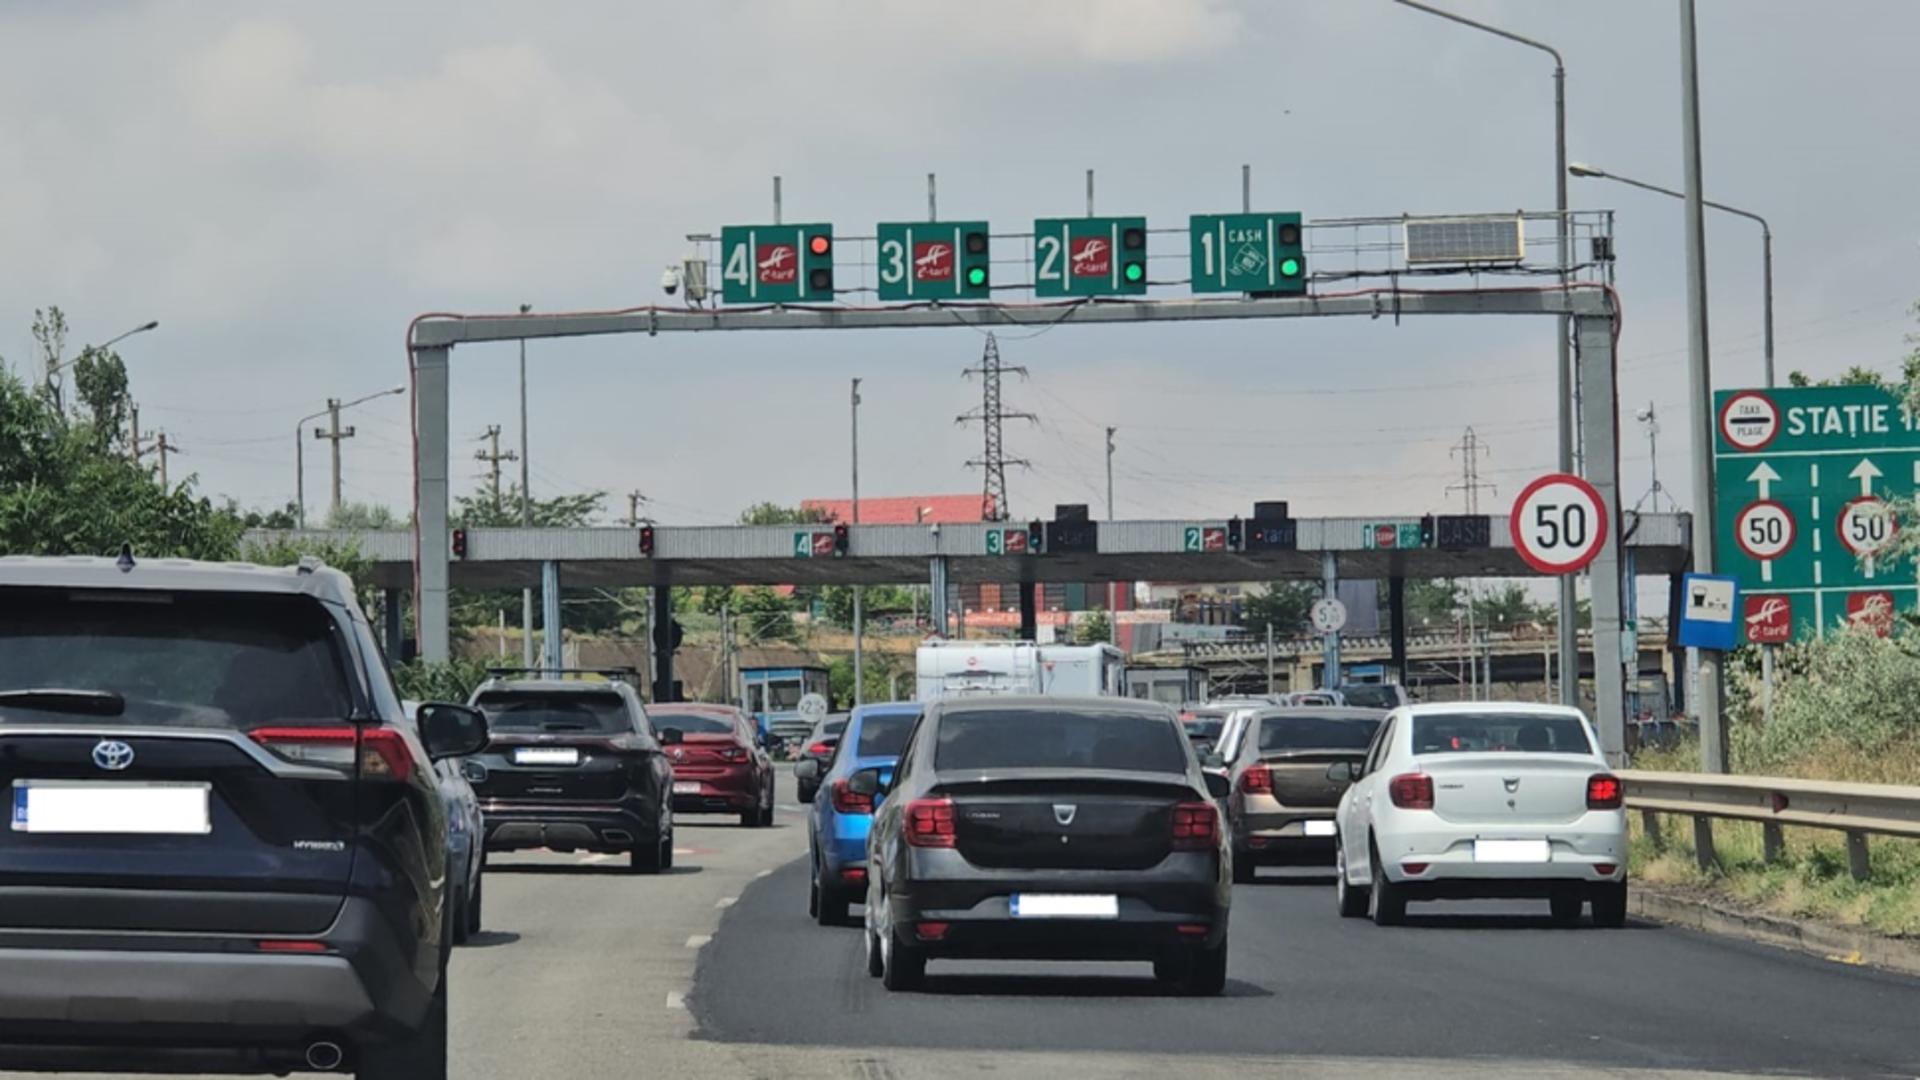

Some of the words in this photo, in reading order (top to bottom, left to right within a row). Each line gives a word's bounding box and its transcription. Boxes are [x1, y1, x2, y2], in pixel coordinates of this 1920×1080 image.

[1228, 229, 1263, 243] CASH
[724, 243, 749, 286] 4
[881, 240, 904, 283] 3
[1038, 236, 1061, 280] 2
[1201, 231, 1214, 276] 1
[1187, 530, 1198, 549] 2
[1536, 504, 1586, 548] 50
[1750, 517, 1782, 544] 50
[1852, 514, 1884, 541] 50
[797, 535, 808, 554] 4
[988, 533, 999, 552] 3
